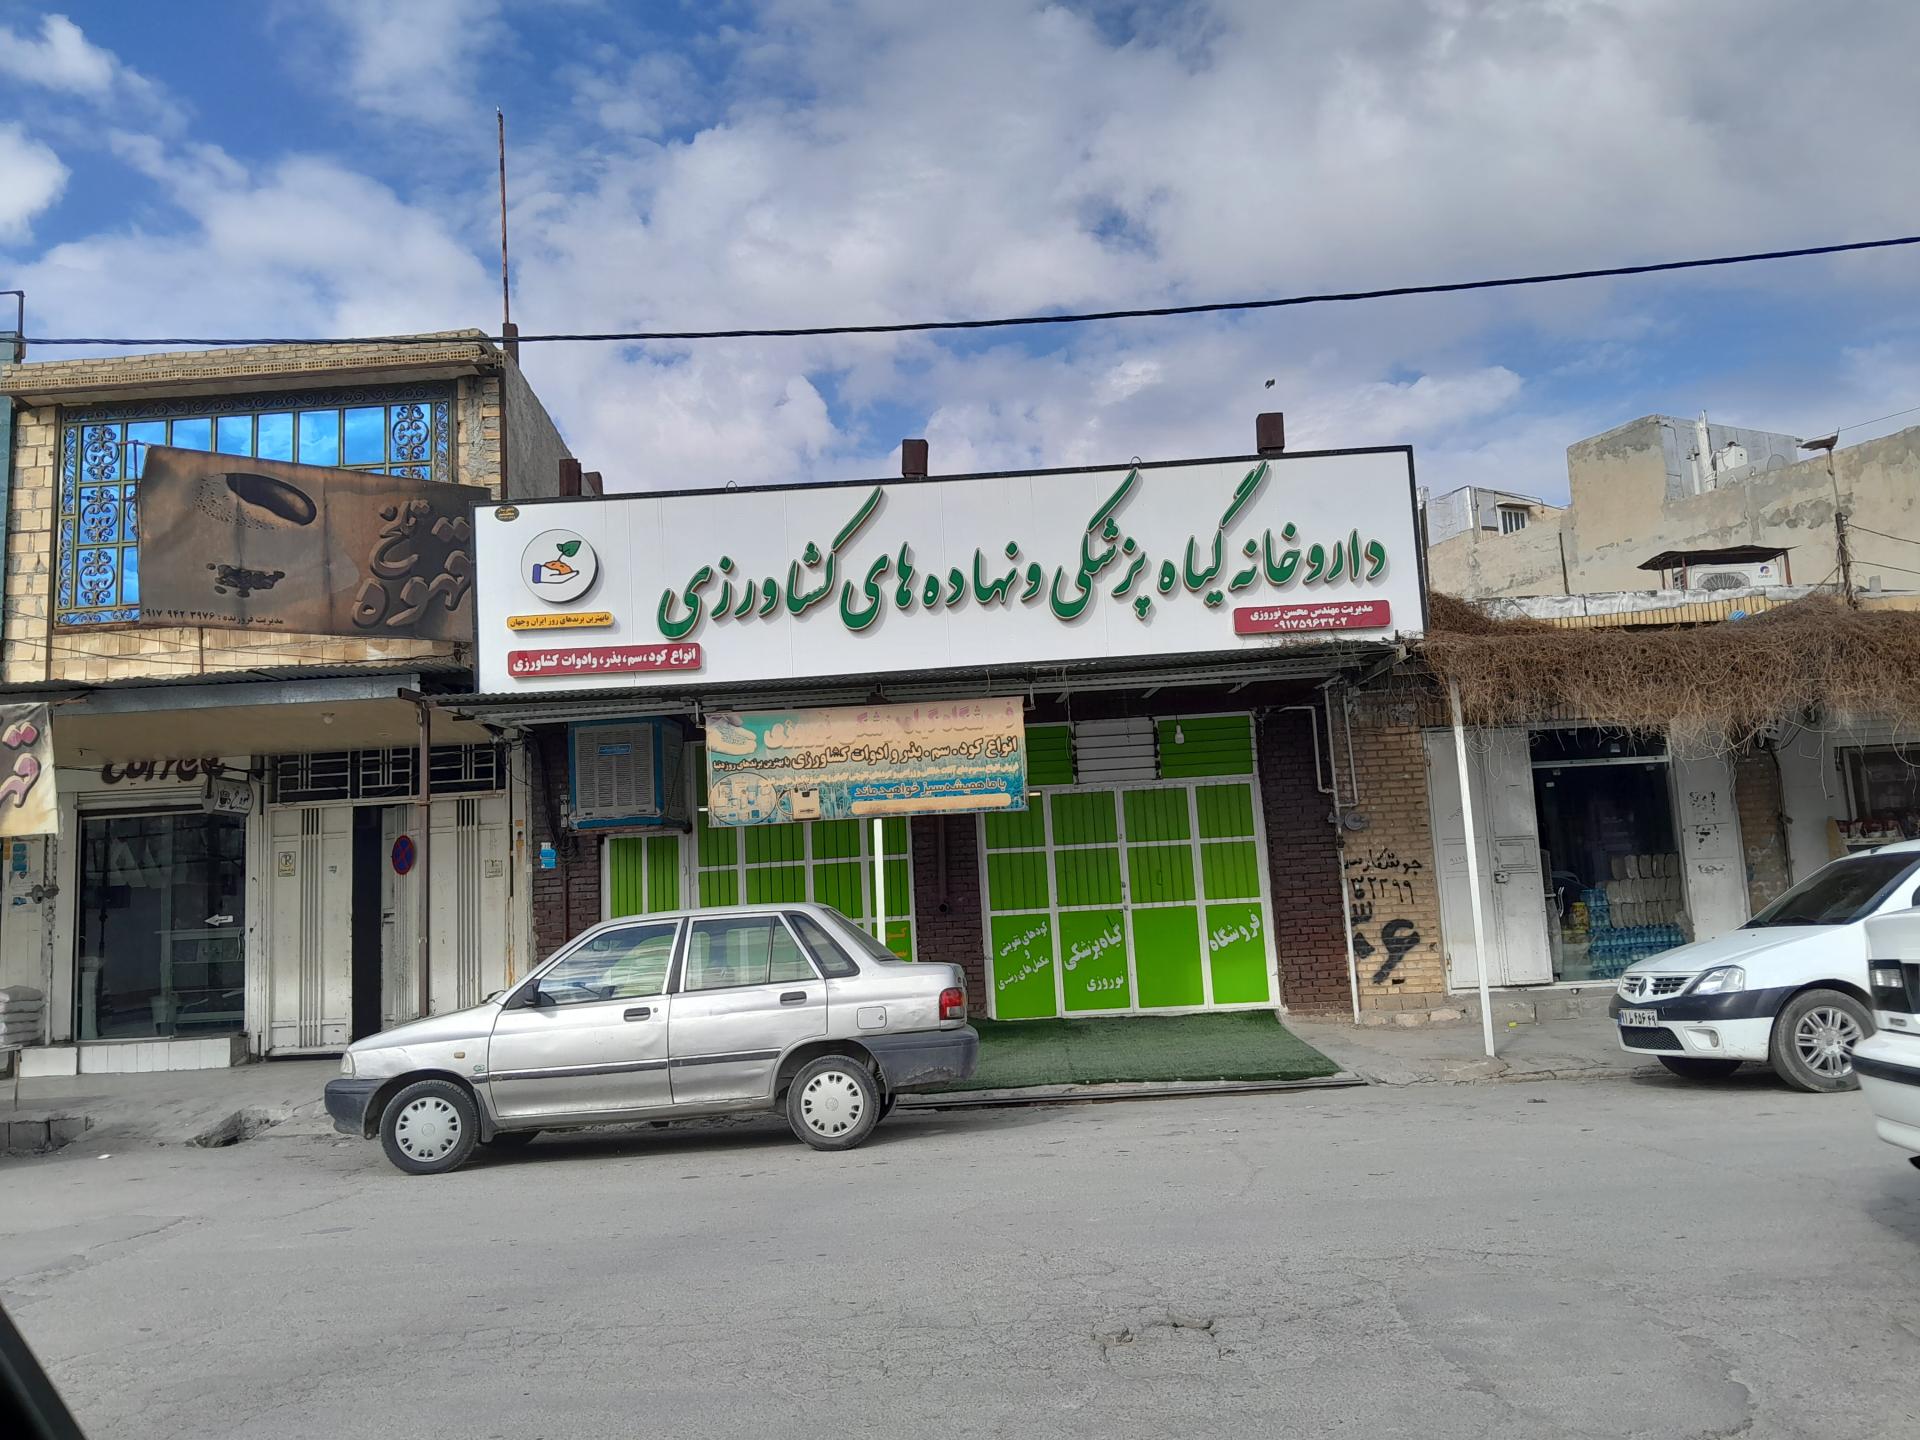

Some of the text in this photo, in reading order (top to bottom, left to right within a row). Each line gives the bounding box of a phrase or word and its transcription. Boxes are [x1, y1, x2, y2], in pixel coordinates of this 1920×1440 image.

[1050, 466, 1152, 620] پزشکی
[1157, 459, 1269, 607] گیاه
[656, 486, 884, 640] کشاورزی
[1228, 521, 1386, 592] داروخانه
[1250, 604, 1373, 621] مدیریت مهندس محسن نوروزی
[512, 653, 560, 672] کشاورزی
[670, 647, 696, 665] انواع
[792, 744, 850, 770] کشاورزی
[900, 741, 923, 764] بذر
[985, 735, 1018, 759] انواع
[855, 785, 884, 797] ماند
[884, 783, 920, 798] خواهید
[921, 781, 945, 796] سبز
[945, 778, 985, 792] همیشه
[1209, 908, 1260, 951] فروشگاه
[1086, 968, 1124, 992] نوروزی
